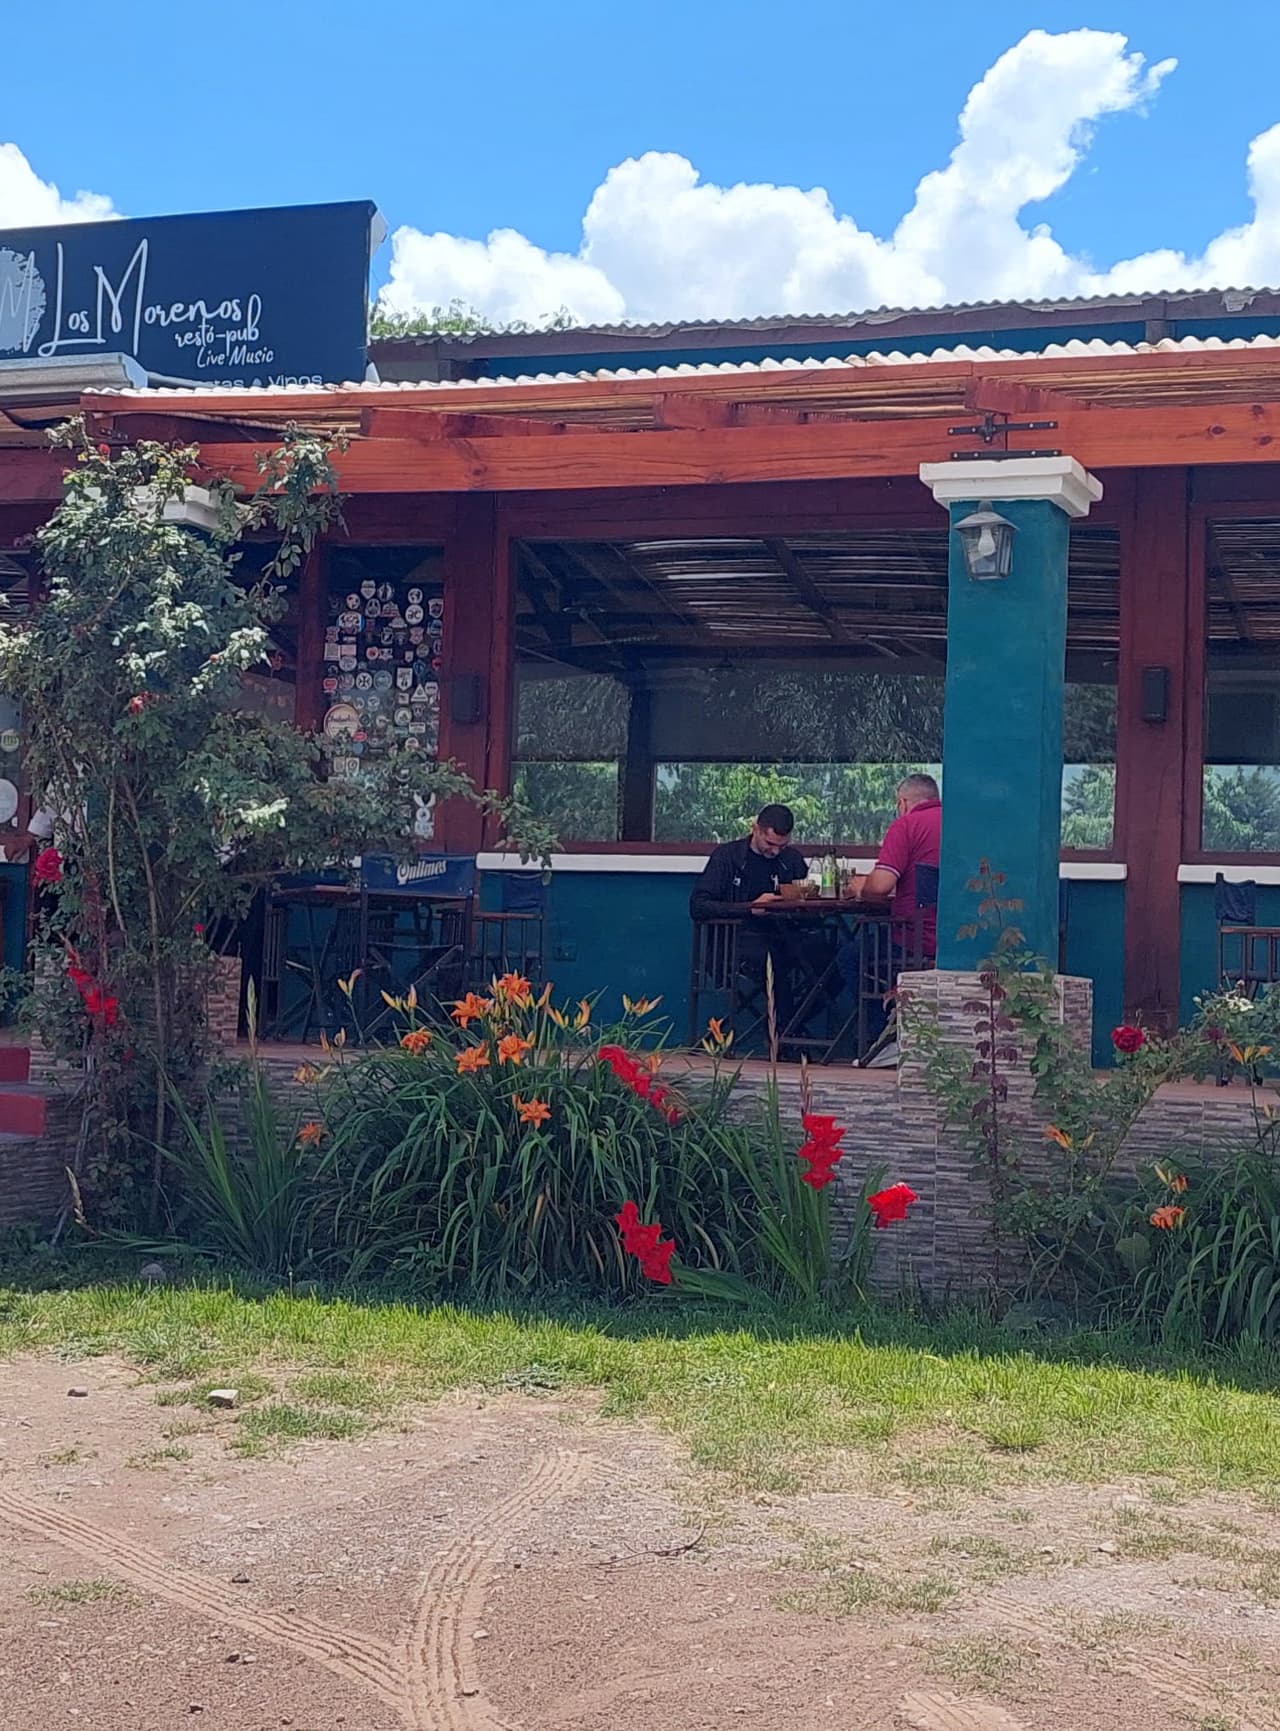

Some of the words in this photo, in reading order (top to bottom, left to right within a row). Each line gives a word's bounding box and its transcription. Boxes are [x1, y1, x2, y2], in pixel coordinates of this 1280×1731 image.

[38, 242, 107, 357] Los
[94, 238, 242, 357] Morenos
[197, 346, 225, 368] Live
[228, 344, 274, 367] Music
